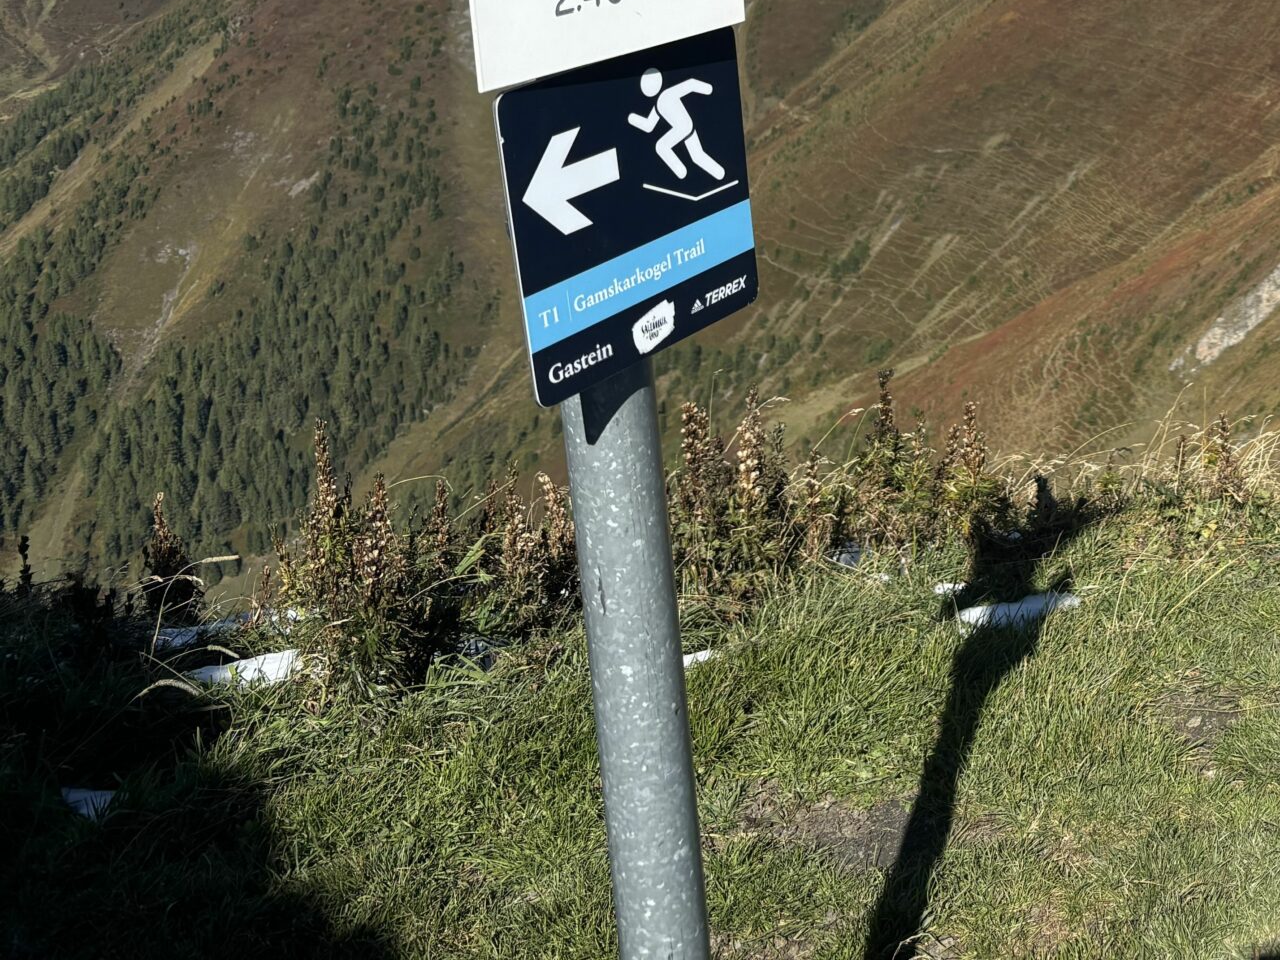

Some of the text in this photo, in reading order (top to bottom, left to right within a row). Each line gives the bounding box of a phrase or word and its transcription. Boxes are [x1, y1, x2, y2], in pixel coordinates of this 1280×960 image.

[538, 238, 706, 329] T1 Gamskarkogel Trail
[705, 274, 747, 307] TERREX
[548, 343, 613, 384] Gastein
